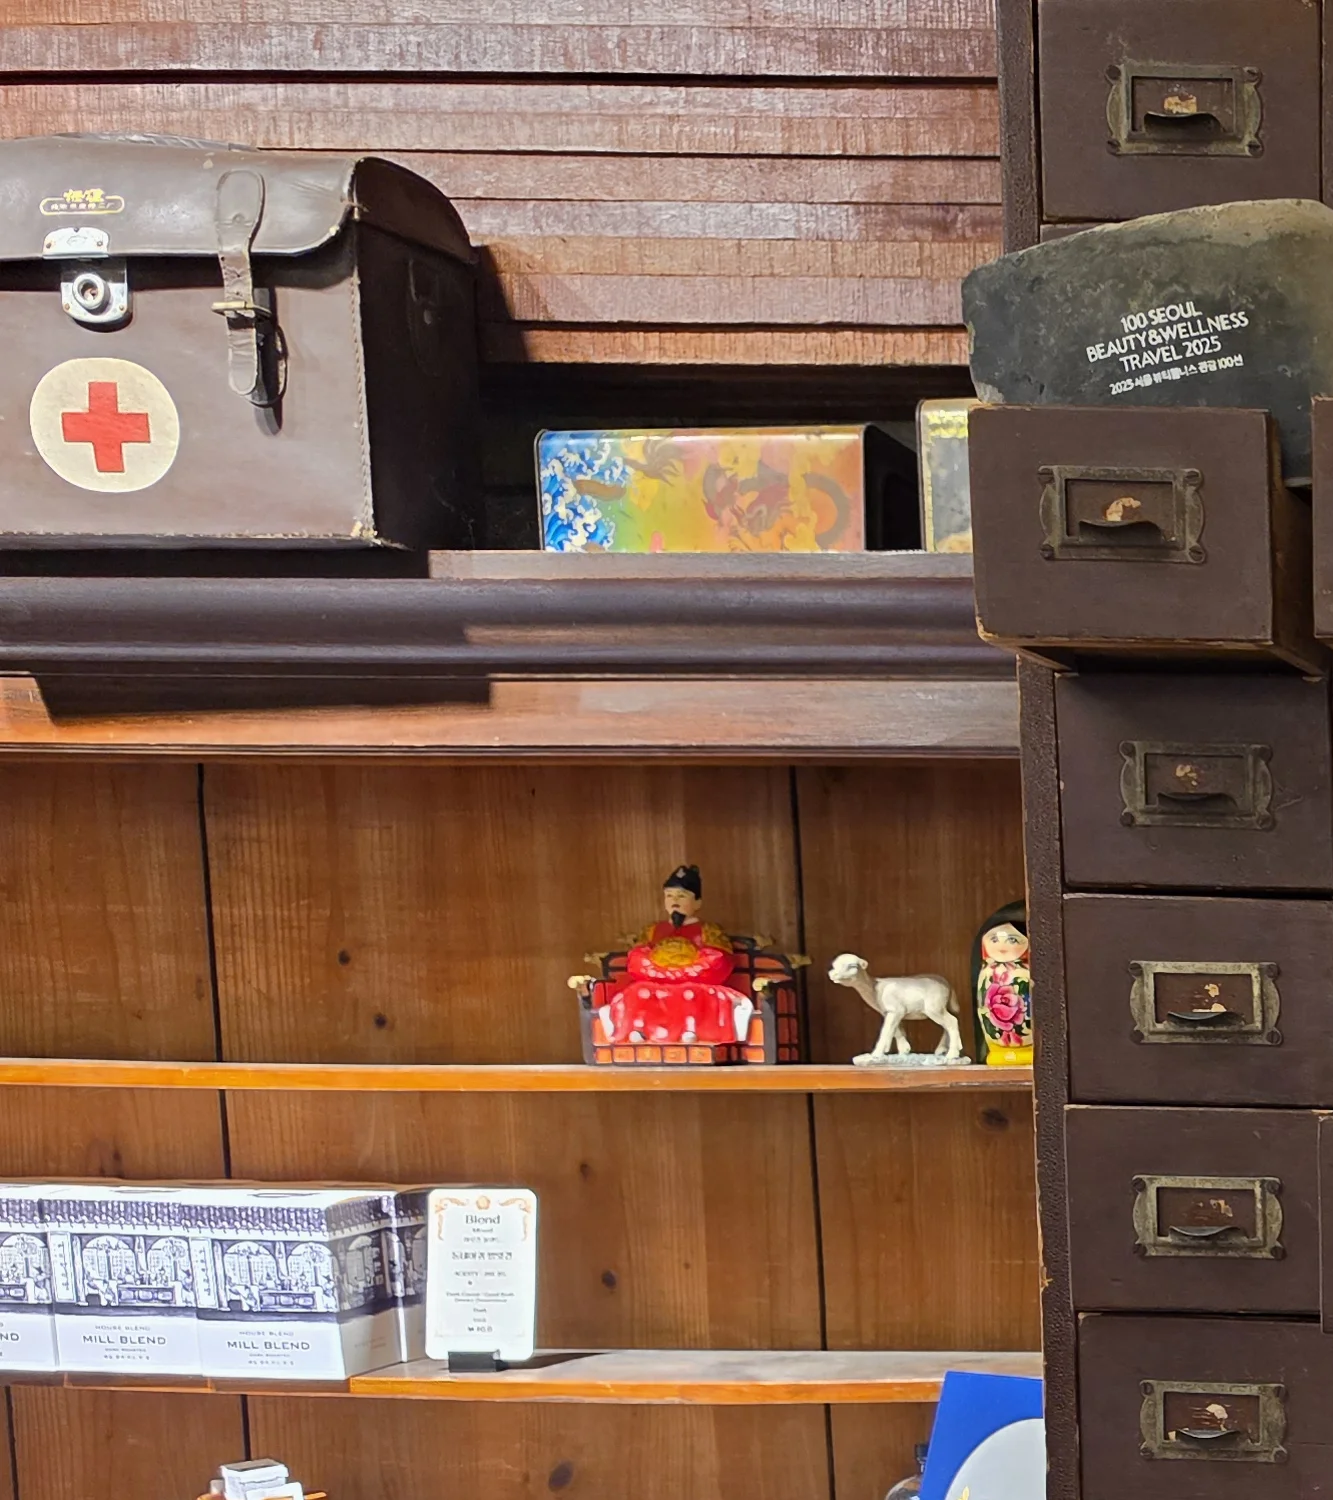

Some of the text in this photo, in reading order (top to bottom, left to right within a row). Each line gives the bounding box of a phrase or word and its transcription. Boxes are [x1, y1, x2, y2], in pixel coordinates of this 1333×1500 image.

[1121, 301, 1202, 333] 100 SEOUL
[1086, 311, 1249, 363] BEAUTY&WELLNESS
[1119, 335, 1222, 373] TRAVEL 2025
[83, 1335, 167, 1345] MILL BLEND
[227, 1340, 310, 1351] MILL BLEND
